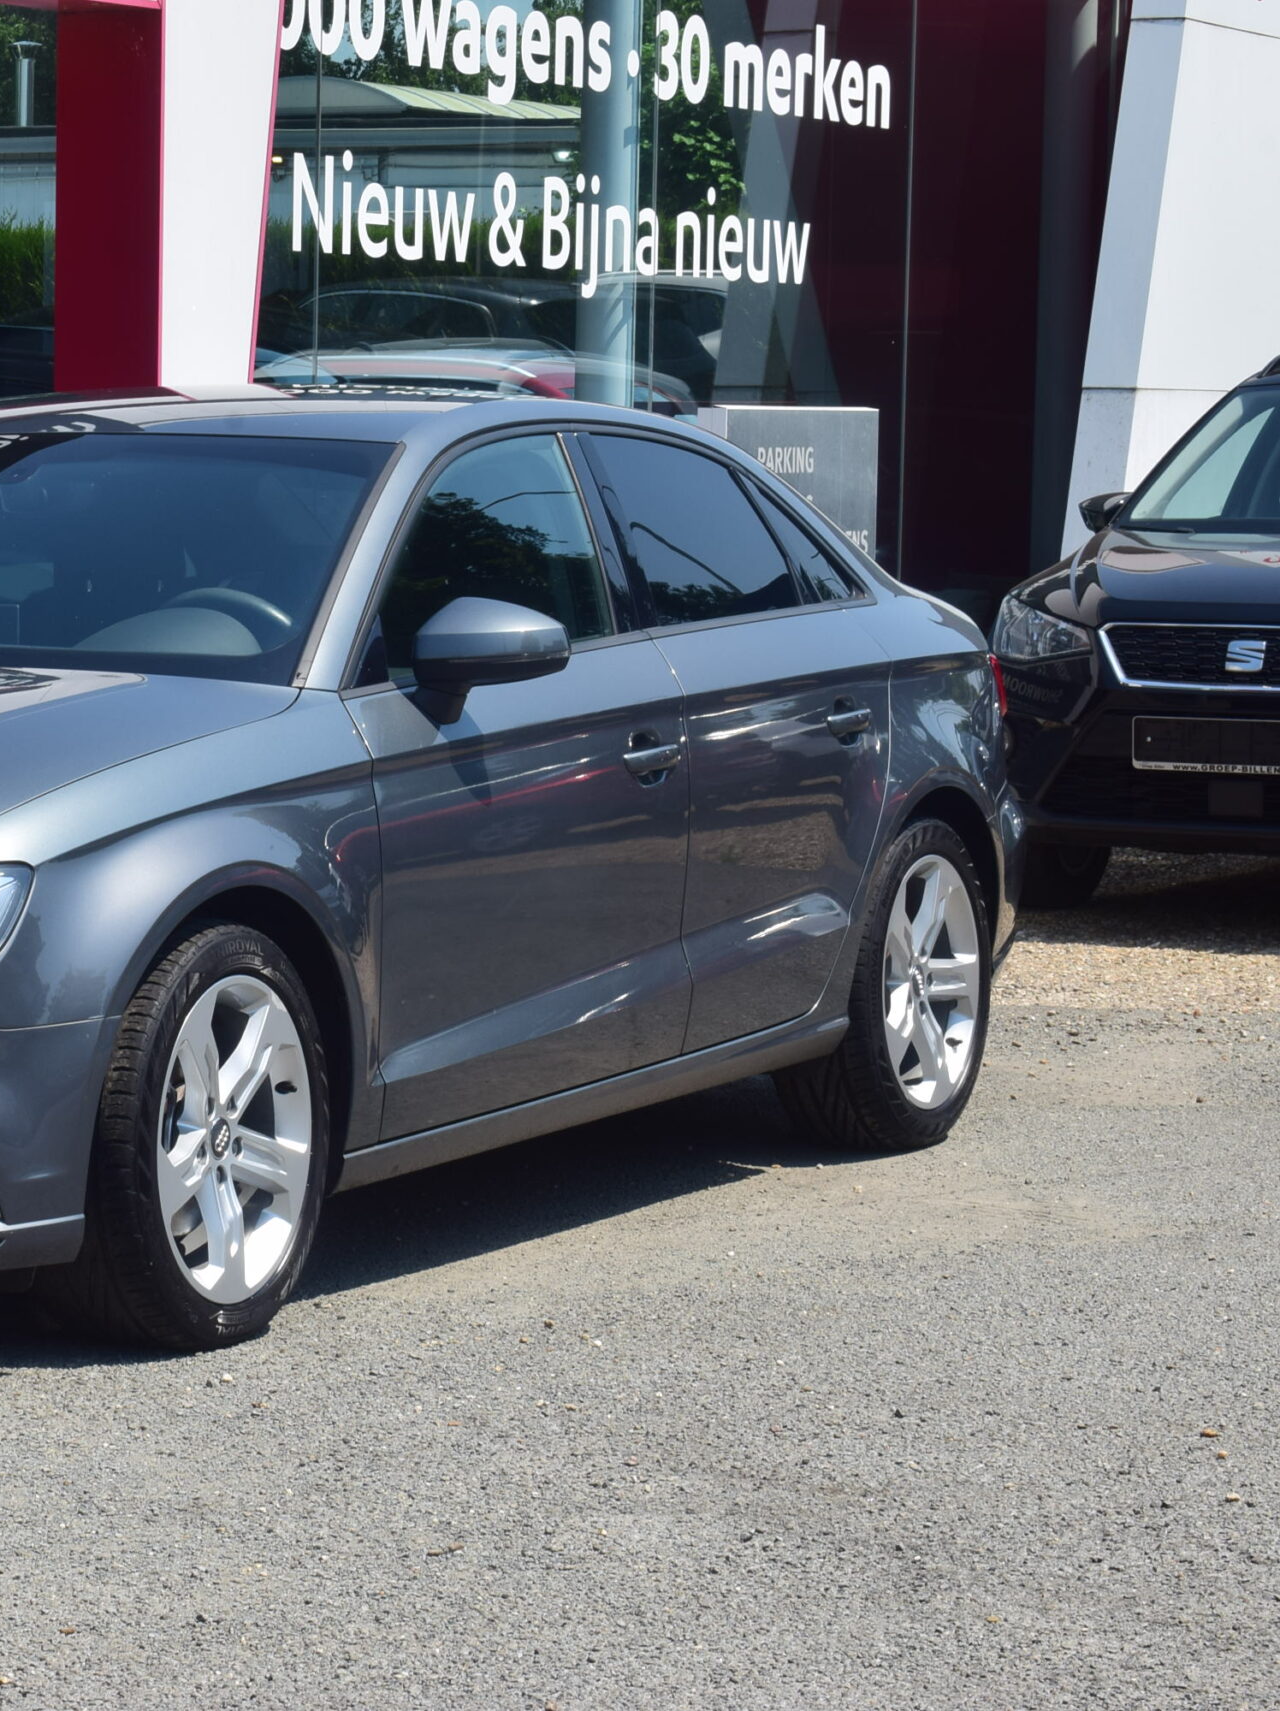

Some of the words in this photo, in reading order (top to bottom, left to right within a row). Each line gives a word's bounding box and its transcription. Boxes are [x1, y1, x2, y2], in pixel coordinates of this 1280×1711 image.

[402, 0, 612, 104] wagens
[654, 10, 710, 103] 30
[724, 24, 891, 130] merken
[292, 150, 475, 263] Nieuw
[489, 172, 527, 267] &
[542, 174, 658, 299] Bijna
[674, 187, 810, 285] nieuw
[757, 447, 814, 473] PARKING
